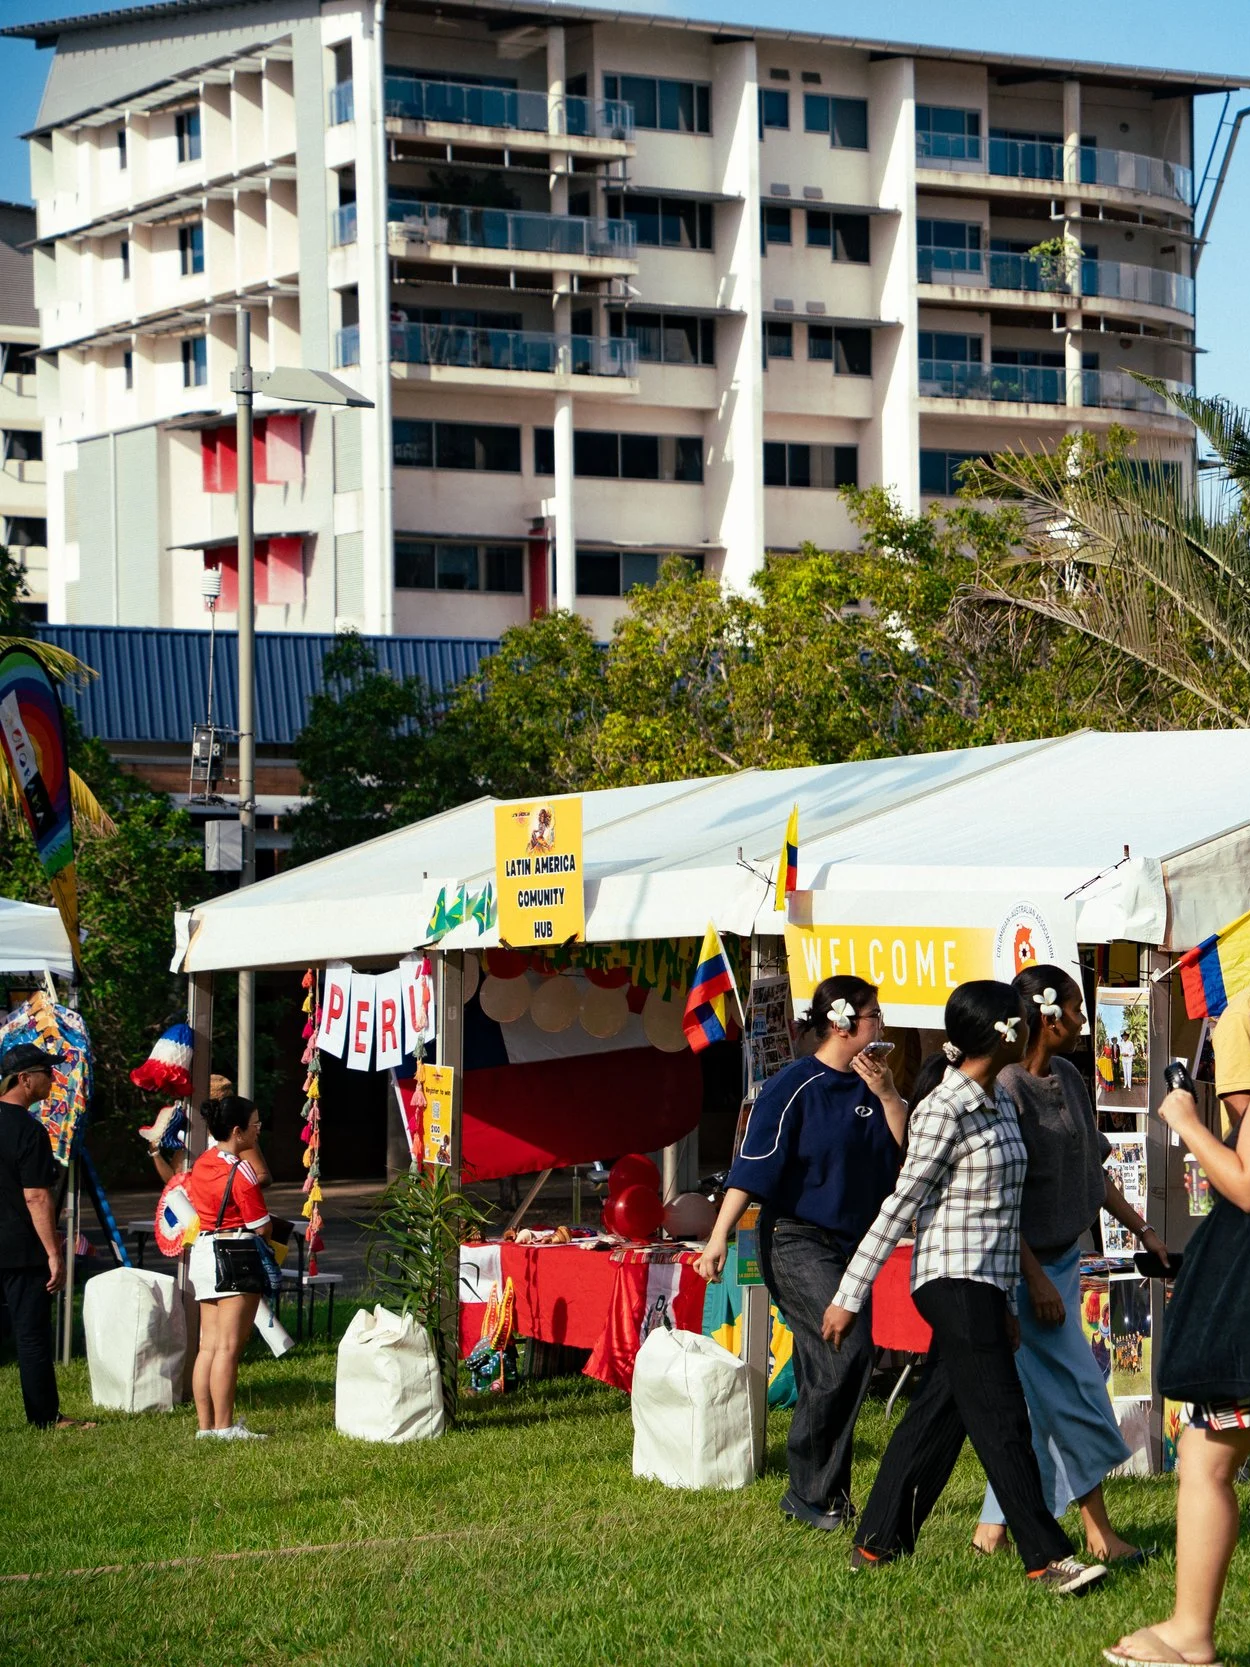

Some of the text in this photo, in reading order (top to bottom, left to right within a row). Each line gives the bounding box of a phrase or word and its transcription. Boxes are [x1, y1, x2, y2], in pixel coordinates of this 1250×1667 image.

[505, 853, 577, 878] LATIN AMERICA
[517, 886, 565, 908] COMUNITY
[534, 920, 553, 940] HUB
[801, 936, 959, 988] WELCOME
